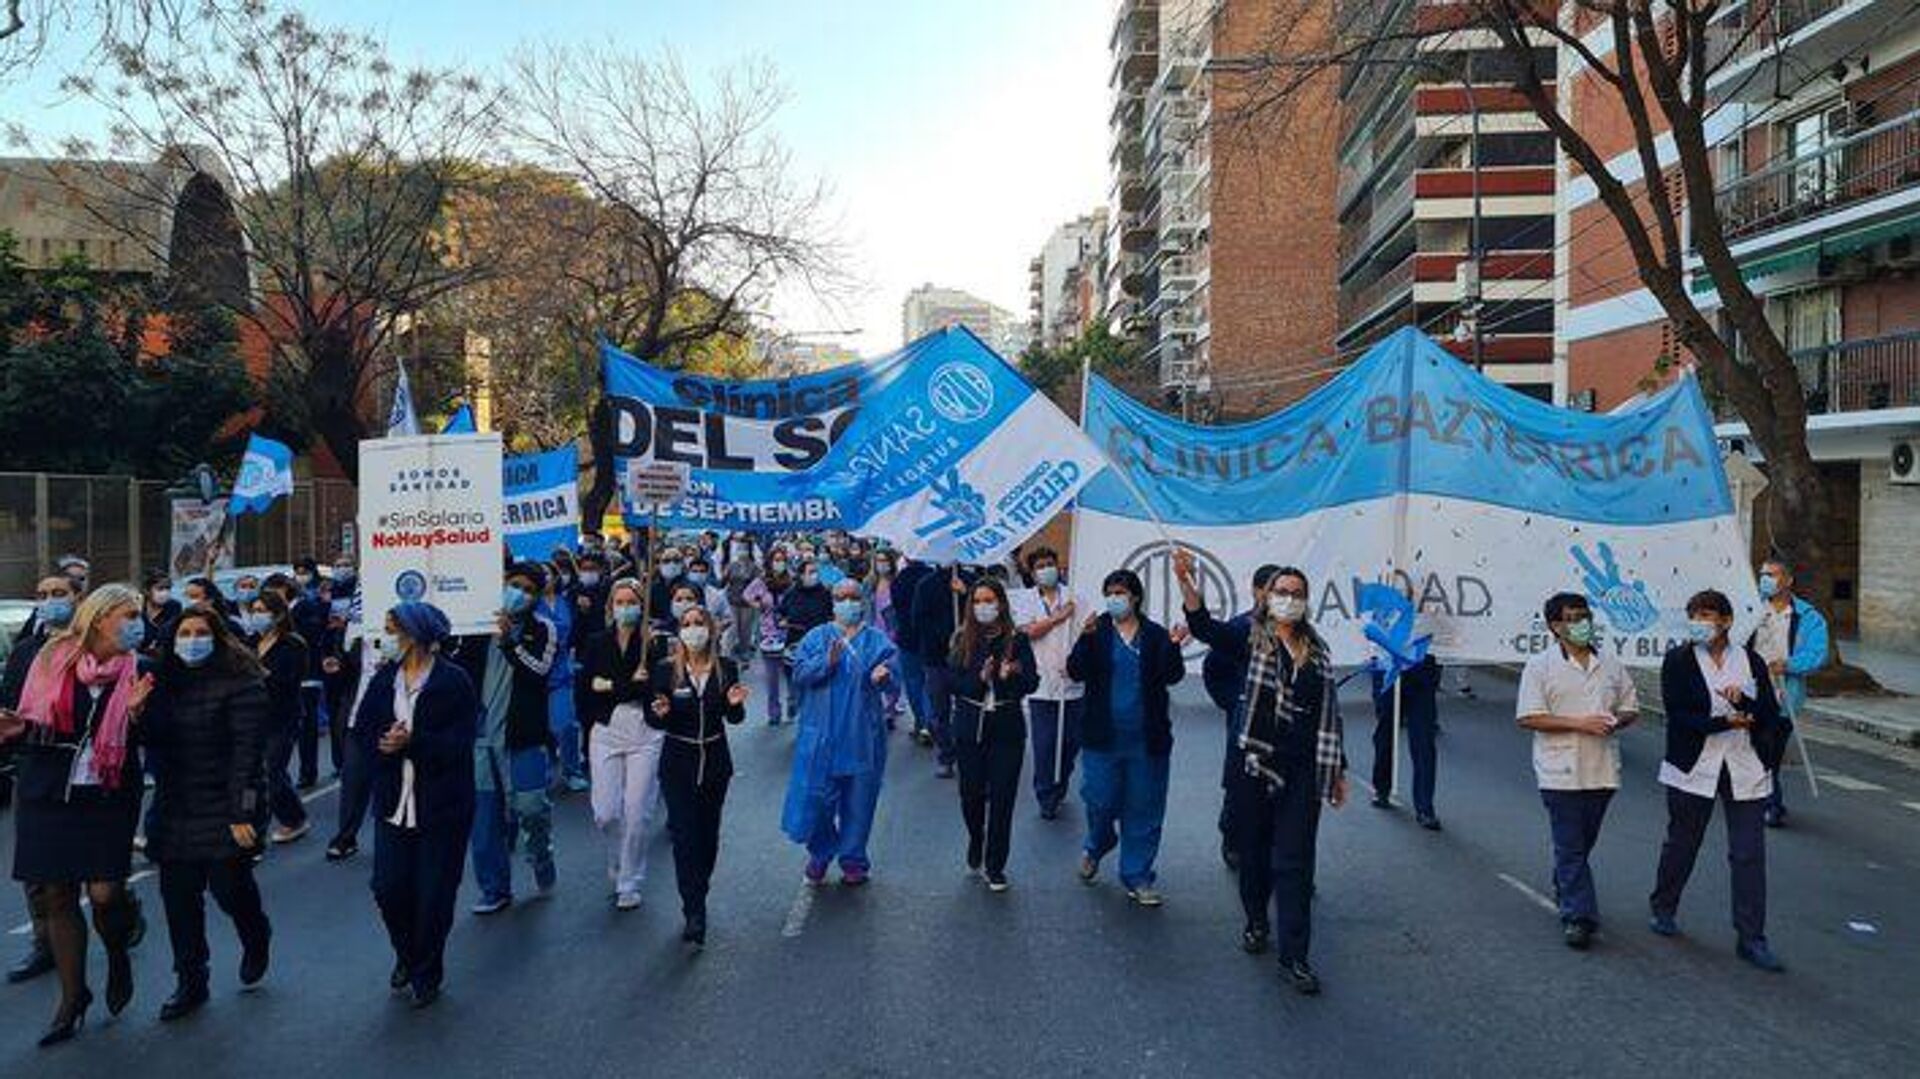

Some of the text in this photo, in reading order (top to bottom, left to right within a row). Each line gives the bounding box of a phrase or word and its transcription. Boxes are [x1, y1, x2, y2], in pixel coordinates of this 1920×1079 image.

[604, 394, 755, 470] DEL
[502, 463, 539, 486] ICA
[379, 509, 485, 530] #SinSalario
[681, 498, 843, 523] SEPTIEMBR
[372, 526, 490, 550] NoHaySalud
